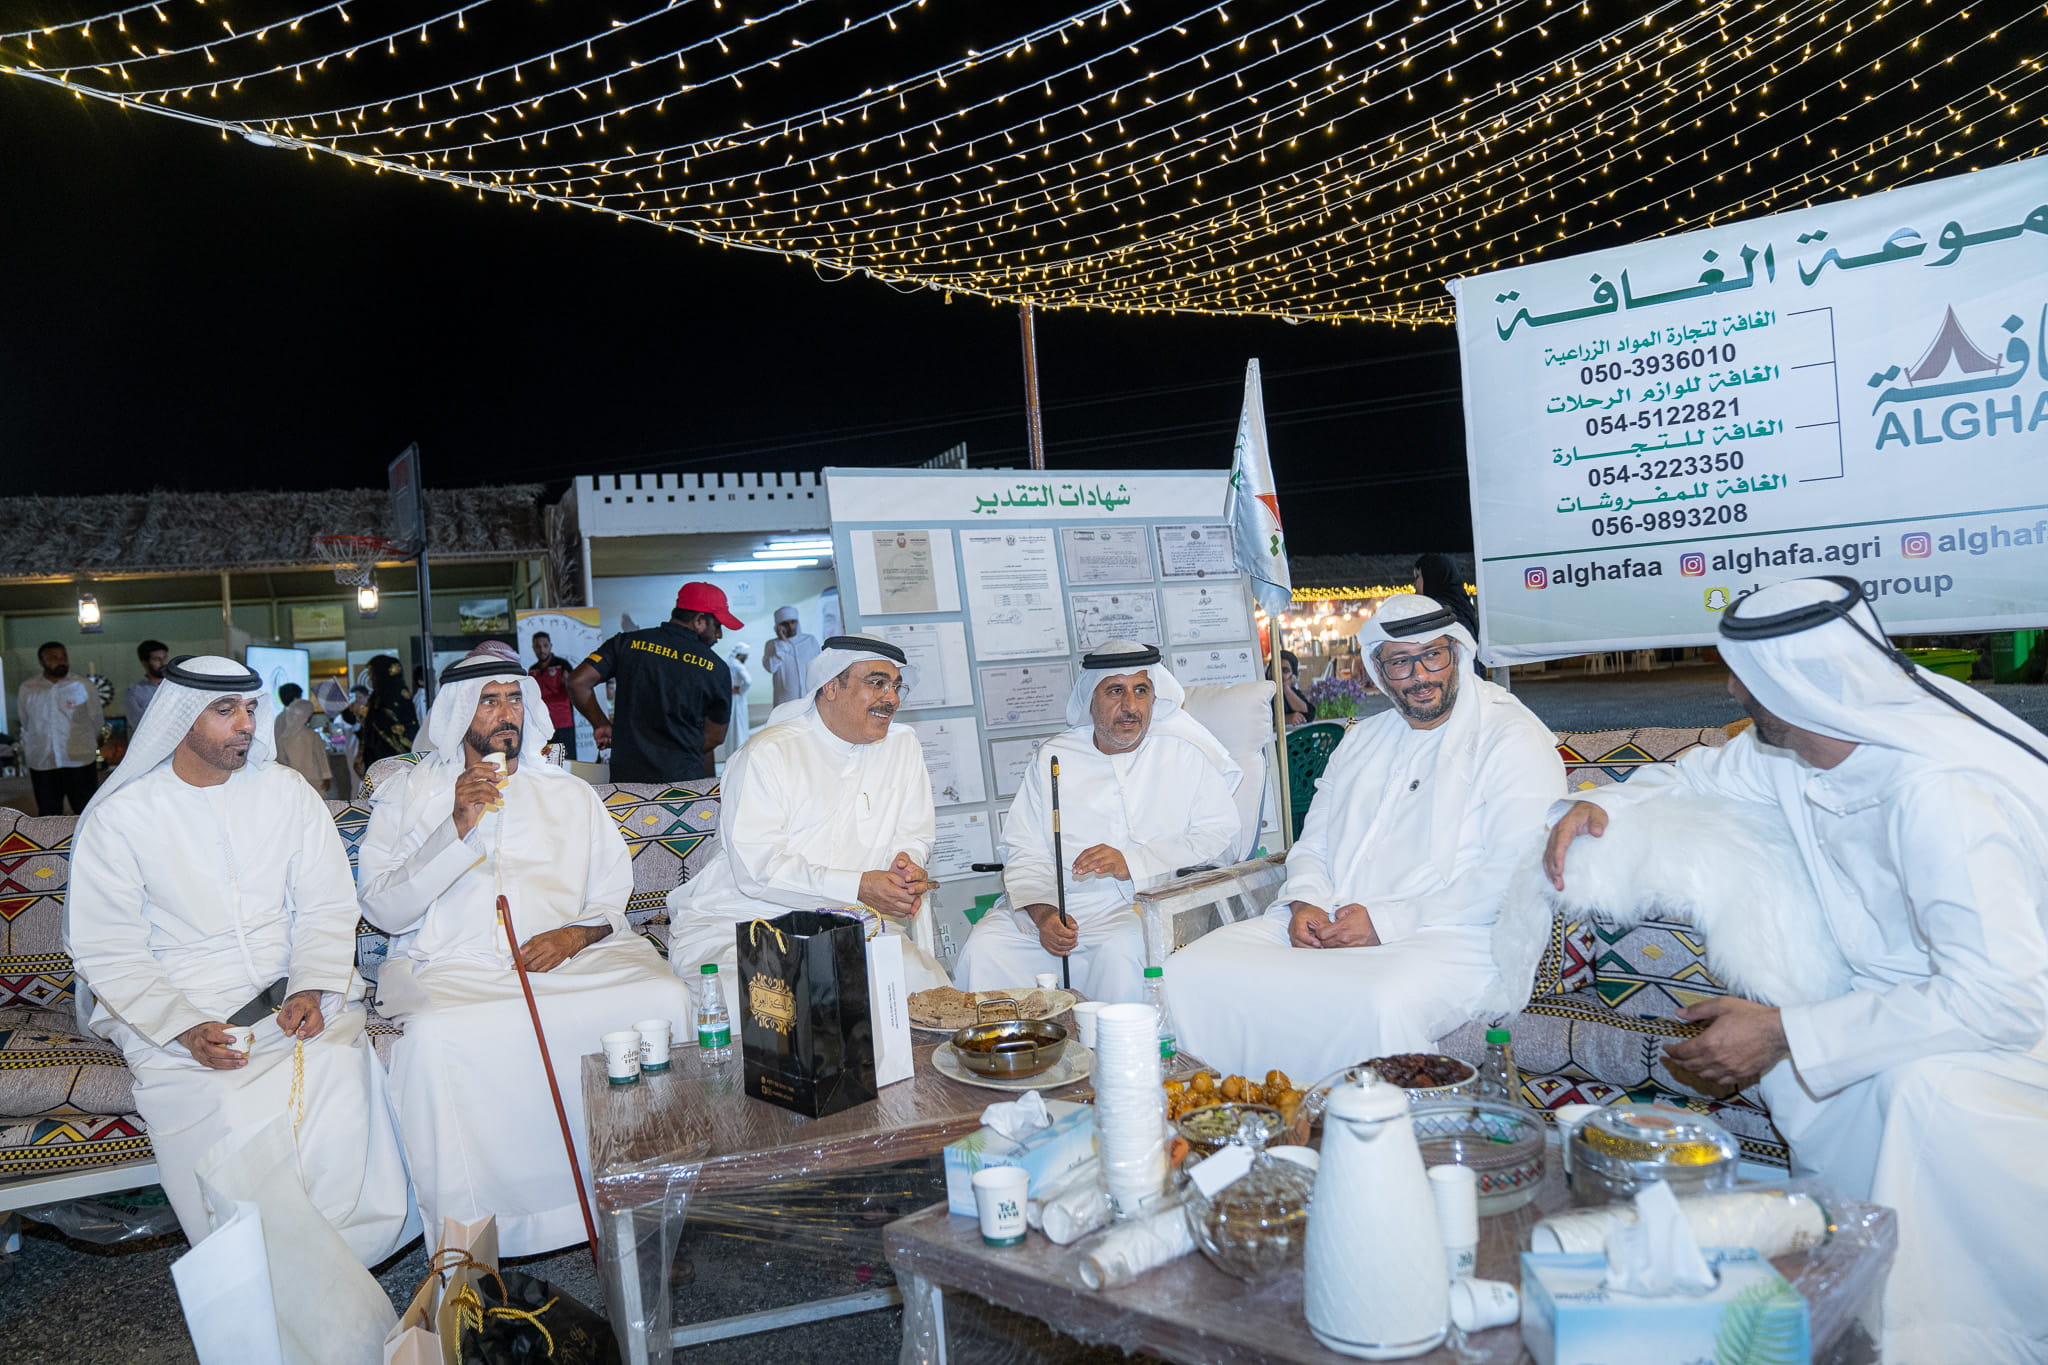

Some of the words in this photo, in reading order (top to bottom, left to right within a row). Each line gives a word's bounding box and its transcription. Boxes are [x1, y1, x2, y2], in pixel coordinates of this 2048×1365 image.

[1496, 243, 1775, 341] الغافة
[1666, 320, 1717, 346] لتجارة
[1722, 310, 1776, 336] الغافة
[1544, 340, 1610, 367] الزراعية
[1617, 331, 1661, 353] المواد
[1580, 343, 1736, 385] 050-3936010
[1709, 365, 1780, 392] الغافة
[1547, 388, 1631, 414] الرحلات
[1640, 376, 1701, 402] للوازم
[1586, 397, 1740, 437] 054-5122821
[1713, 419, 1783, 445] الغافة
[1588, 451, 1744, 487] 054-3223350
[971, 483, 1054, 514] التقدير
[1059, 484, 1130, 512] شهادات
[1556, 481, 1709, 513] للمفروشات
[1716, 473, 1787, 498] الغافة
[1591, 503, 1748, 536] 056-9893208
[1712, 536, 1881, 574] alghafa.agri
[1552, 558, 1663, 588] alghafaa
[630, 640, 679, 660] MLEEHA
[682, 653, 715, 671] CLUB
